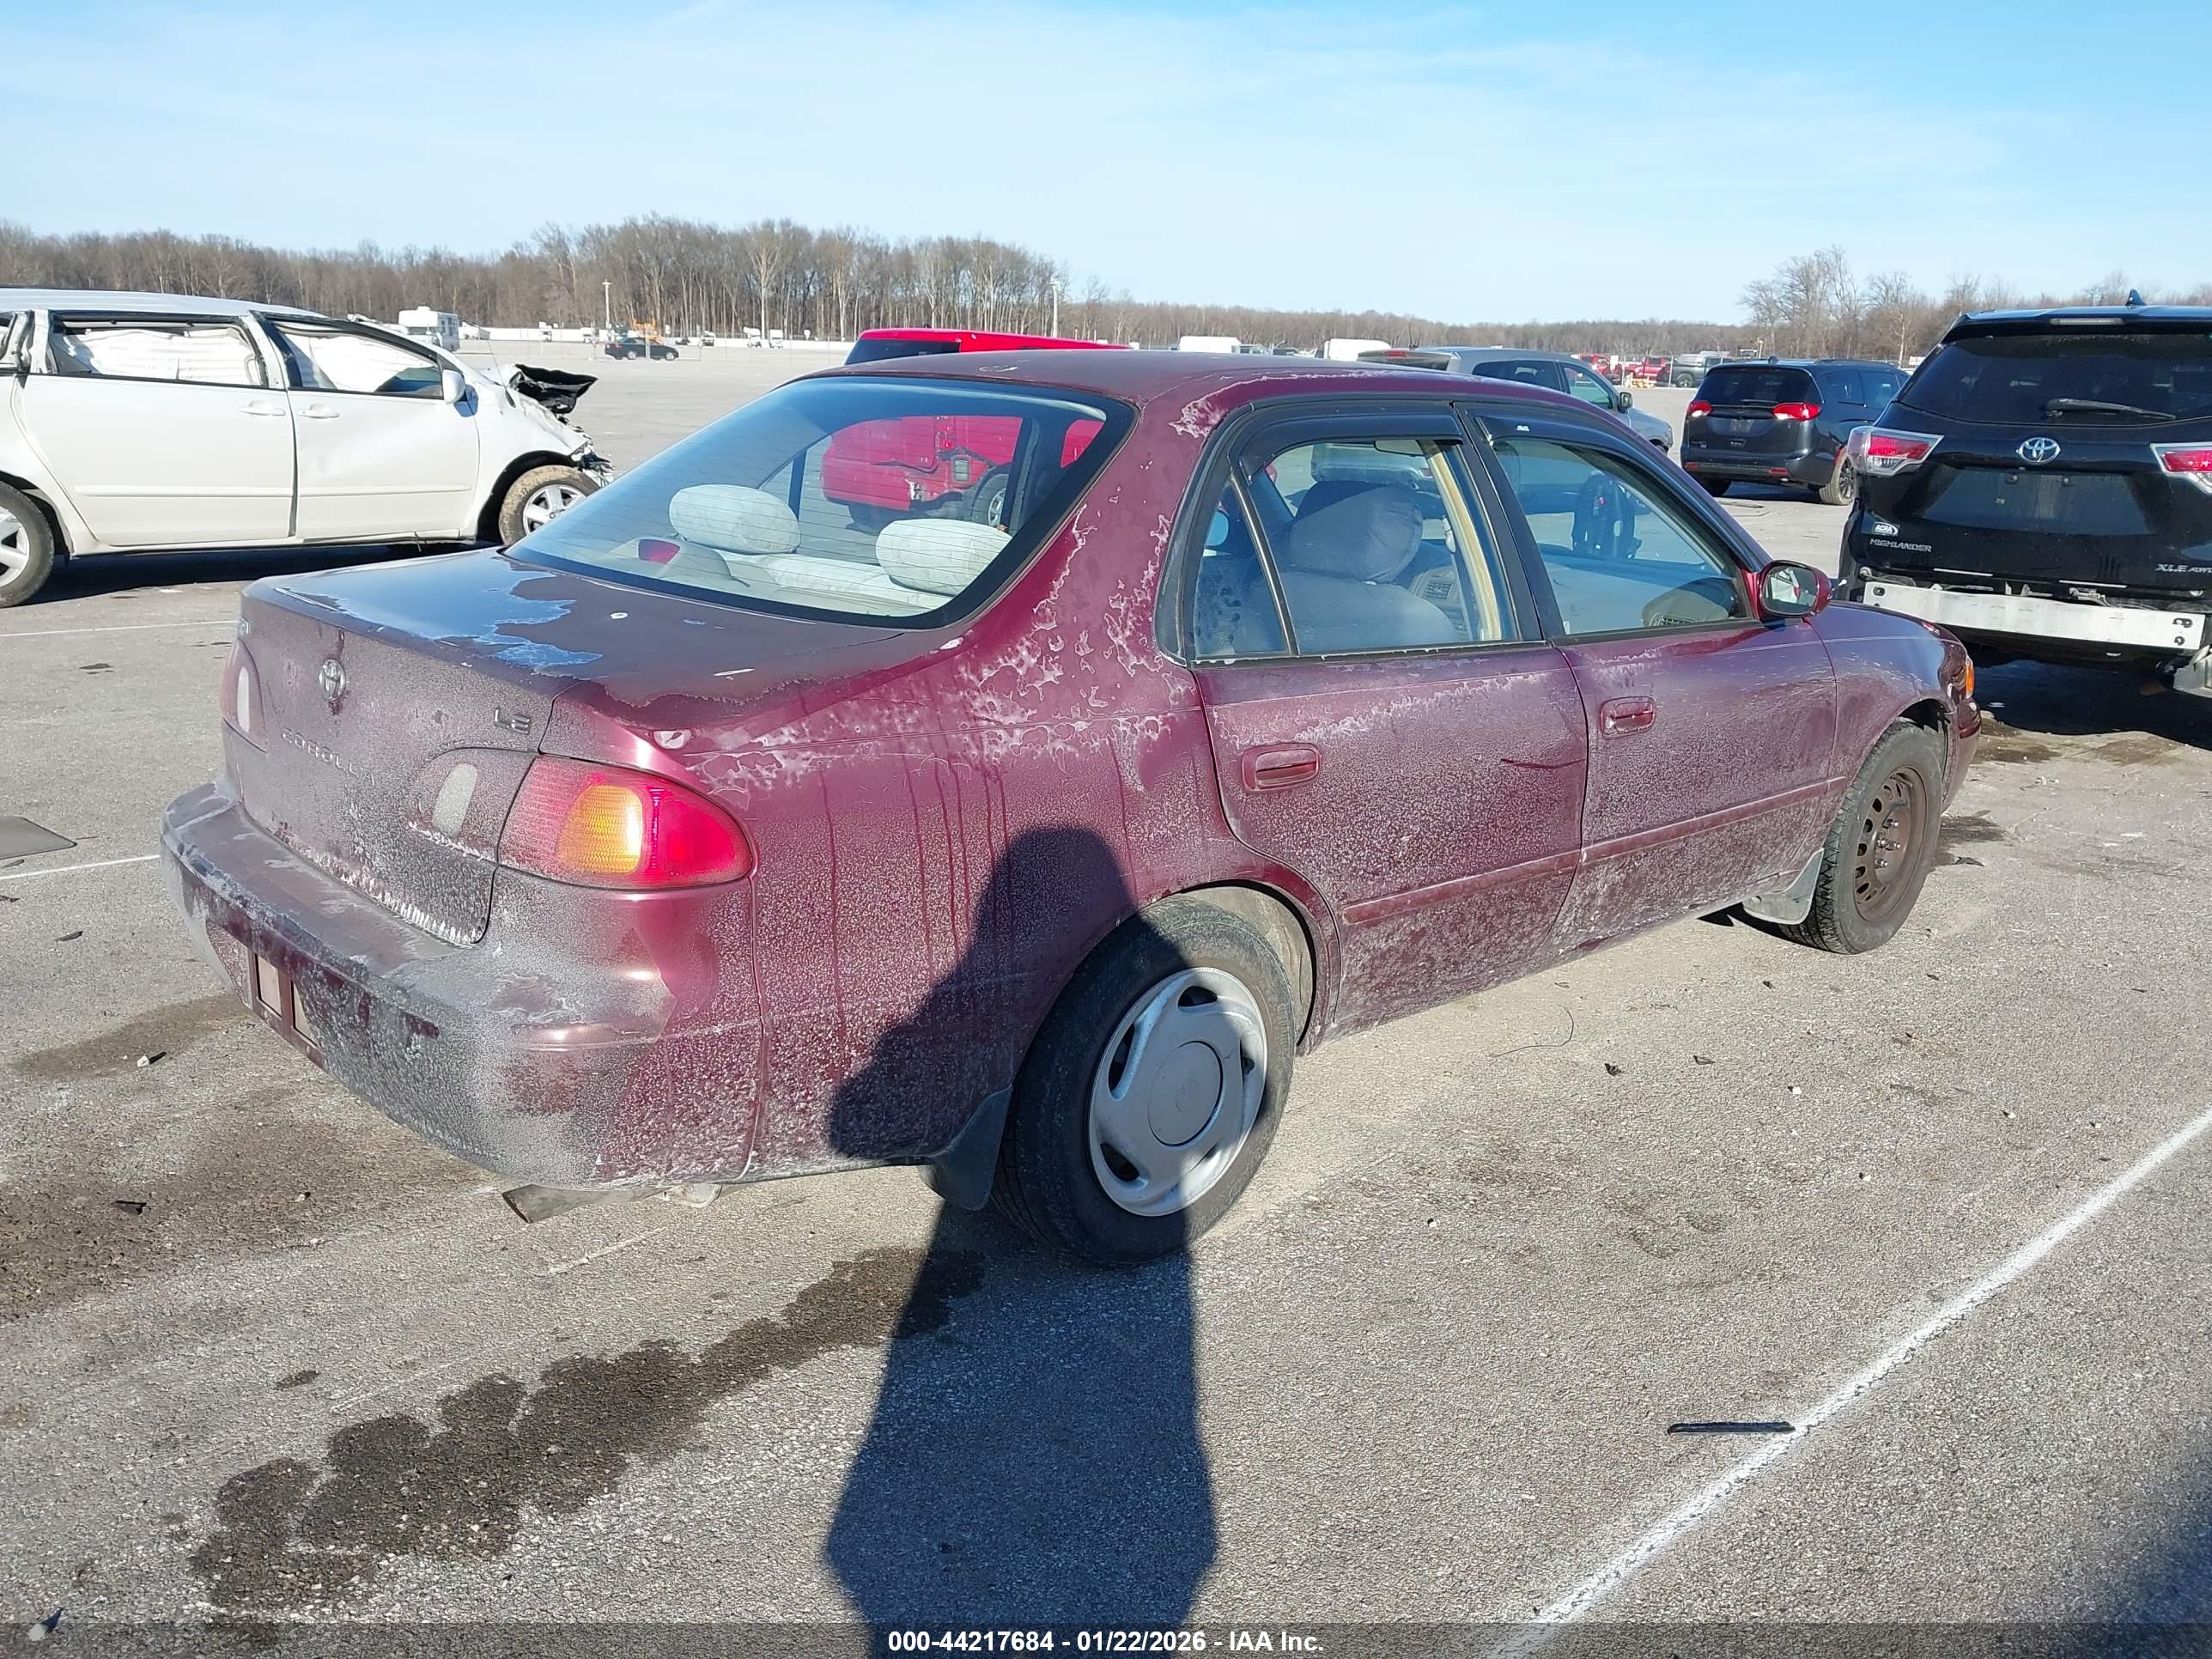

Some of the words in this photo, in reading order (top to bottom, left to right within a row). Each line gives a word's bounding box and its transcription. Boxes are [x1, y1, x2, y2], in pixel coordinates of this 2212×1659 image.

[1869, 538, 1932, 552] HIGHLANDER
[2154, 563, 2188, 572] XLE
[494, 708, 531, 734] LE
[281, 727, 375, 787] COROLLA
